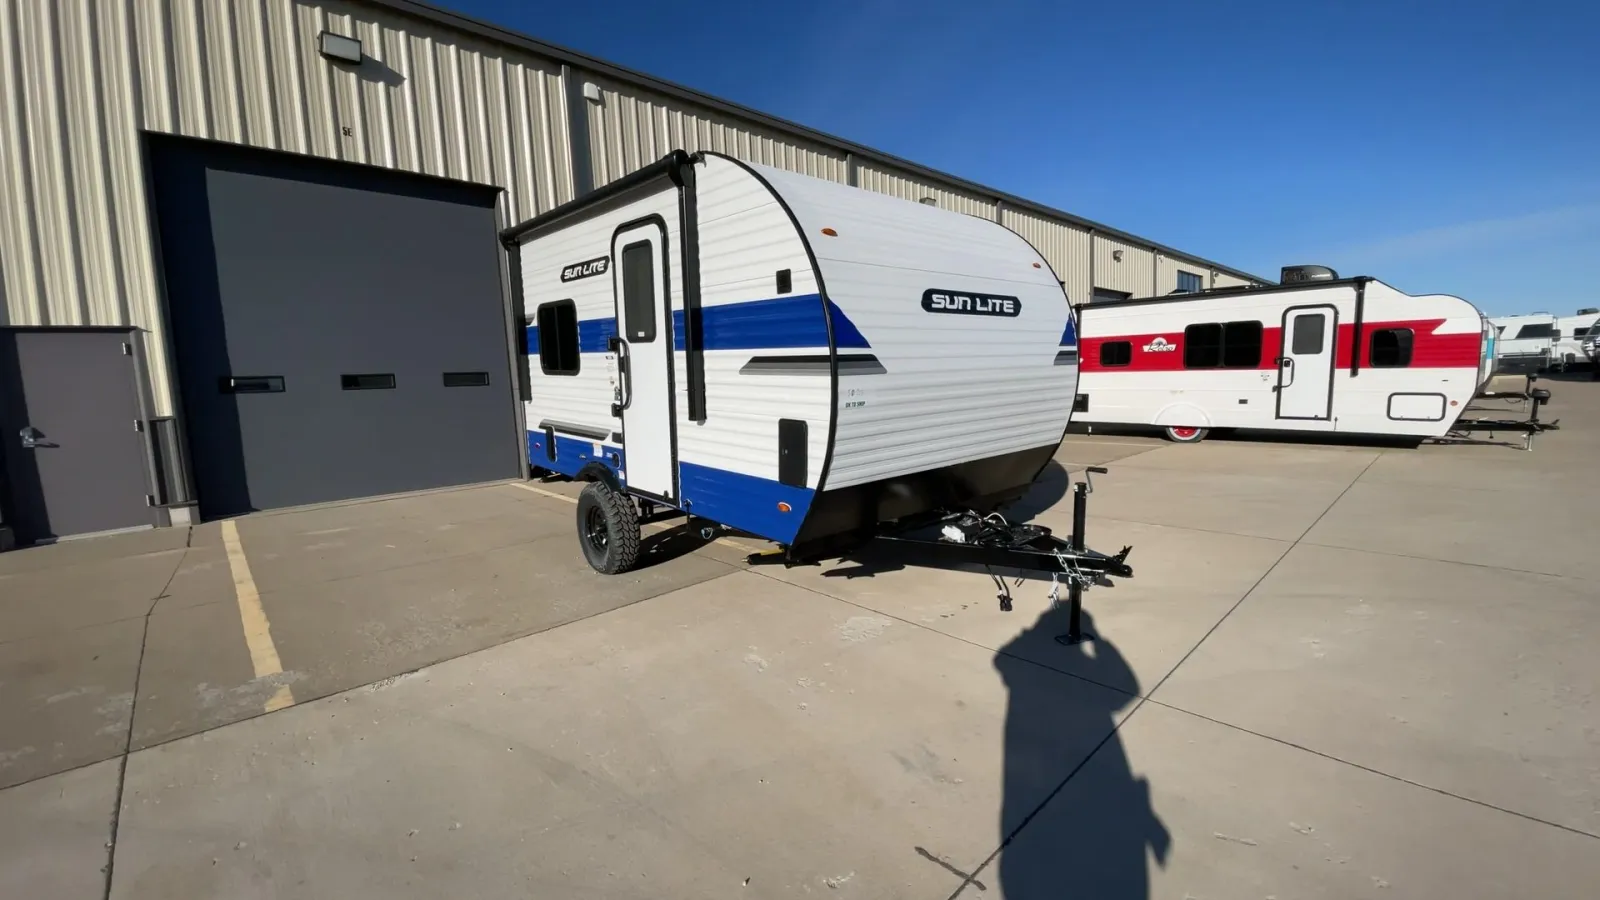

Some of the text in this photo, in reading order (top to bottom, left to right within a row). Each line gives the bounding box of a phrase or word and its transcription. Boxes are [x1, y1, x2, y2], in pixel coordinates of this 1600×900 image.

[564, 260, 606, 280] SUN LITE
[931, 294, 1014, 313] SUN LITE
